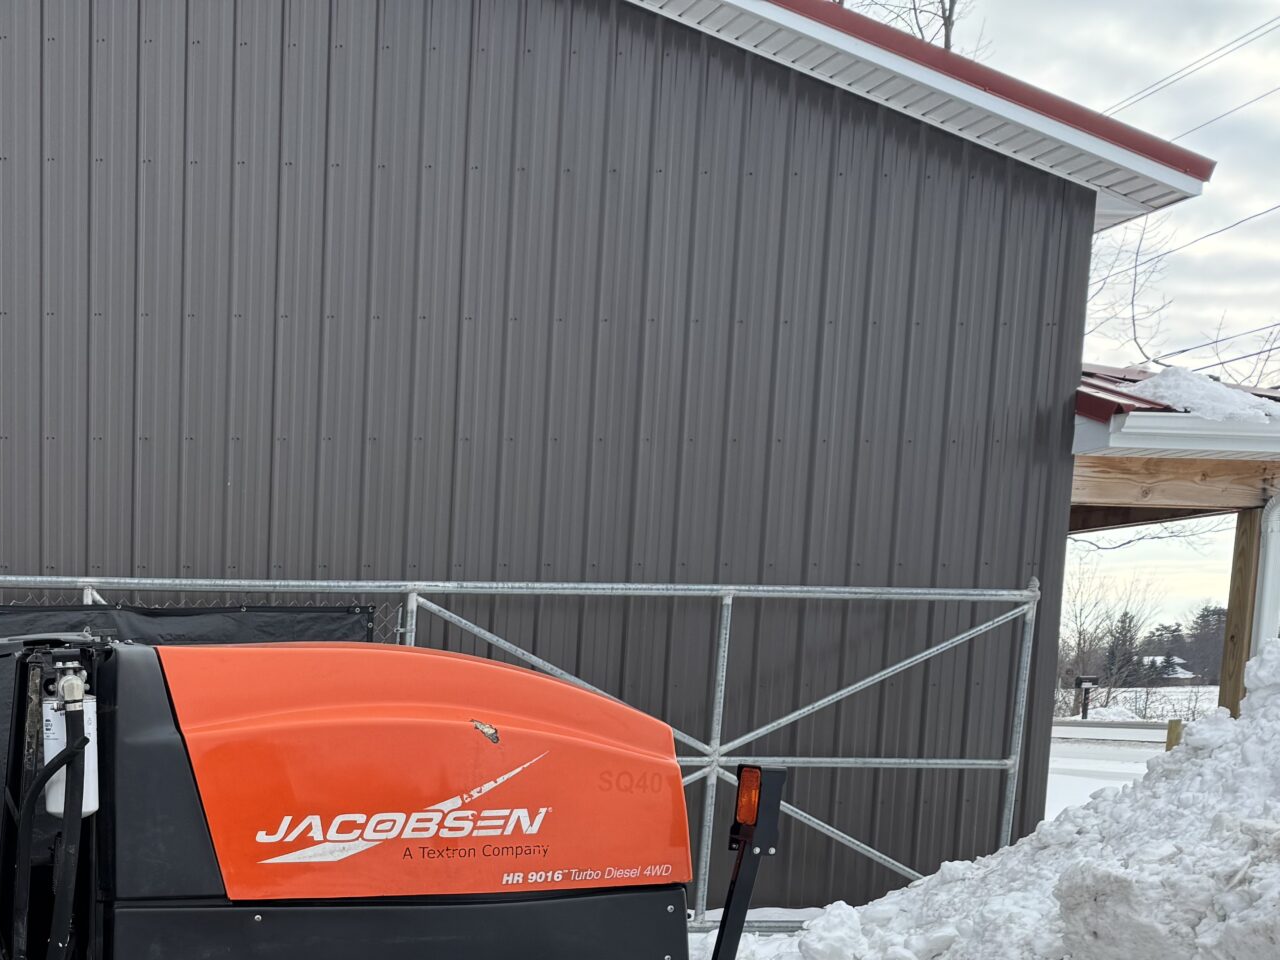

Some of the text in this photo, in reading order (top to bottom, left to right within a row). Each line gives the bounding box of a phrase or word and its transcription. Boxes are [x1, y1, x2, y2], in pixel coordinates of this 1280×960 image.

[597, 770, 663, 794] SQ40
[255, 807, 548, 843] JACOBSEN
[402, 844, 549, 860] A Textron Company
[501, 873, 524, 885] HR
[569, 869, 602, 881] Turbo
[604, 866, 642, 879] Diesel
[643, 865, 672, 876] 4WD
